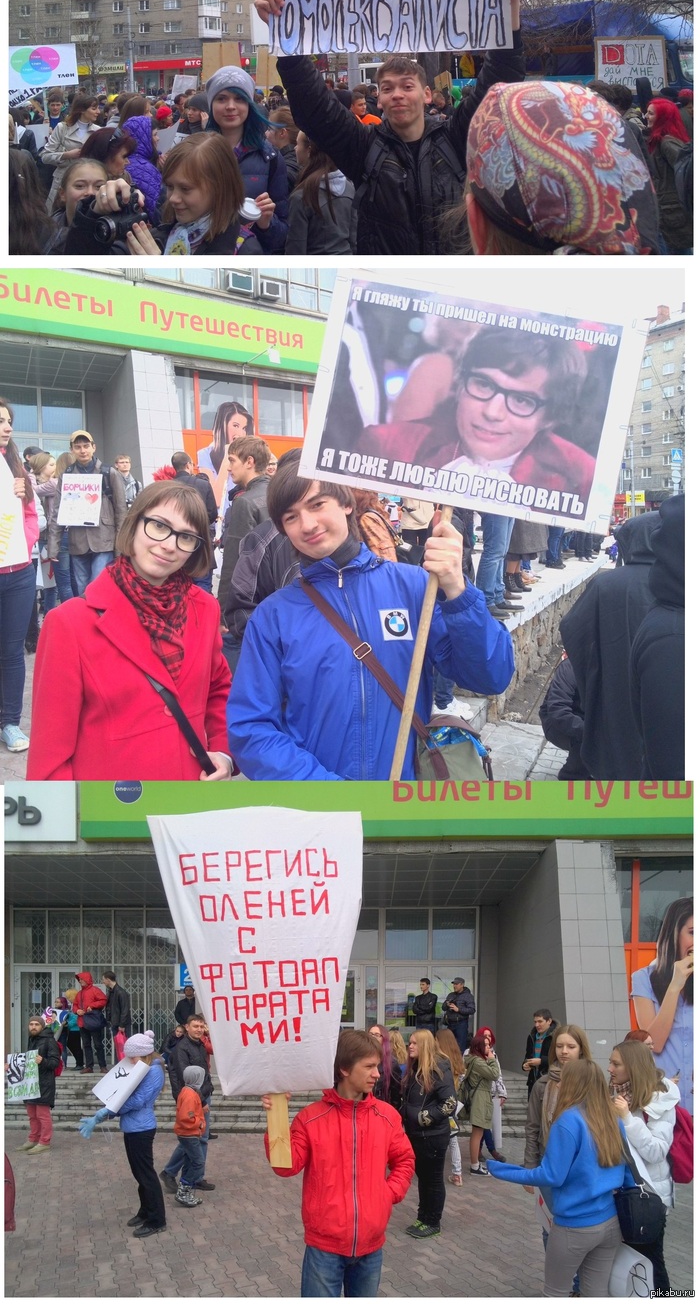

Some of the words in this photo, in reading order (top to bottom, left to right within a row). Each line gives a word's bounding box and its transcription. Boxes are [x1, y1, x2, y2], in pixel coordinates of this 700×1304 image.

[184, 59, 201, 67] МТС
[629, 66, 654, 76] МНЕ
[139, 300, 304, 349] Путешествия
[351, 286, 364, 301] Я
[364, 289, 409, 311] гляжу
[412, 297, 434, 314] ты
[435, 302, 497, 326] пришел
[498, 314, 517, 329] на
[519, 318, 619, 347] монстрацию
[320, 448, 335, 468] Я
[338, 451, 388, 479] ТОЖЕ
[388, 461, 471, 495] ЛЮБЛЮ
[470, 475, 586, 516] РИСКОВАТЬ
[392, 781, 532, 802] Билеты
[179, 847, 339, 886] БЕРЕГИСЬ
[199, 881, 330, 922] ОЛЕНЕЙ
[238, 926, 257, 954] С
[199, 957, 340, 993] ФОТОАП
[211, 987, 330, 1022] ПАРАТА
[240, 1016, 302, 1047] МИ!
